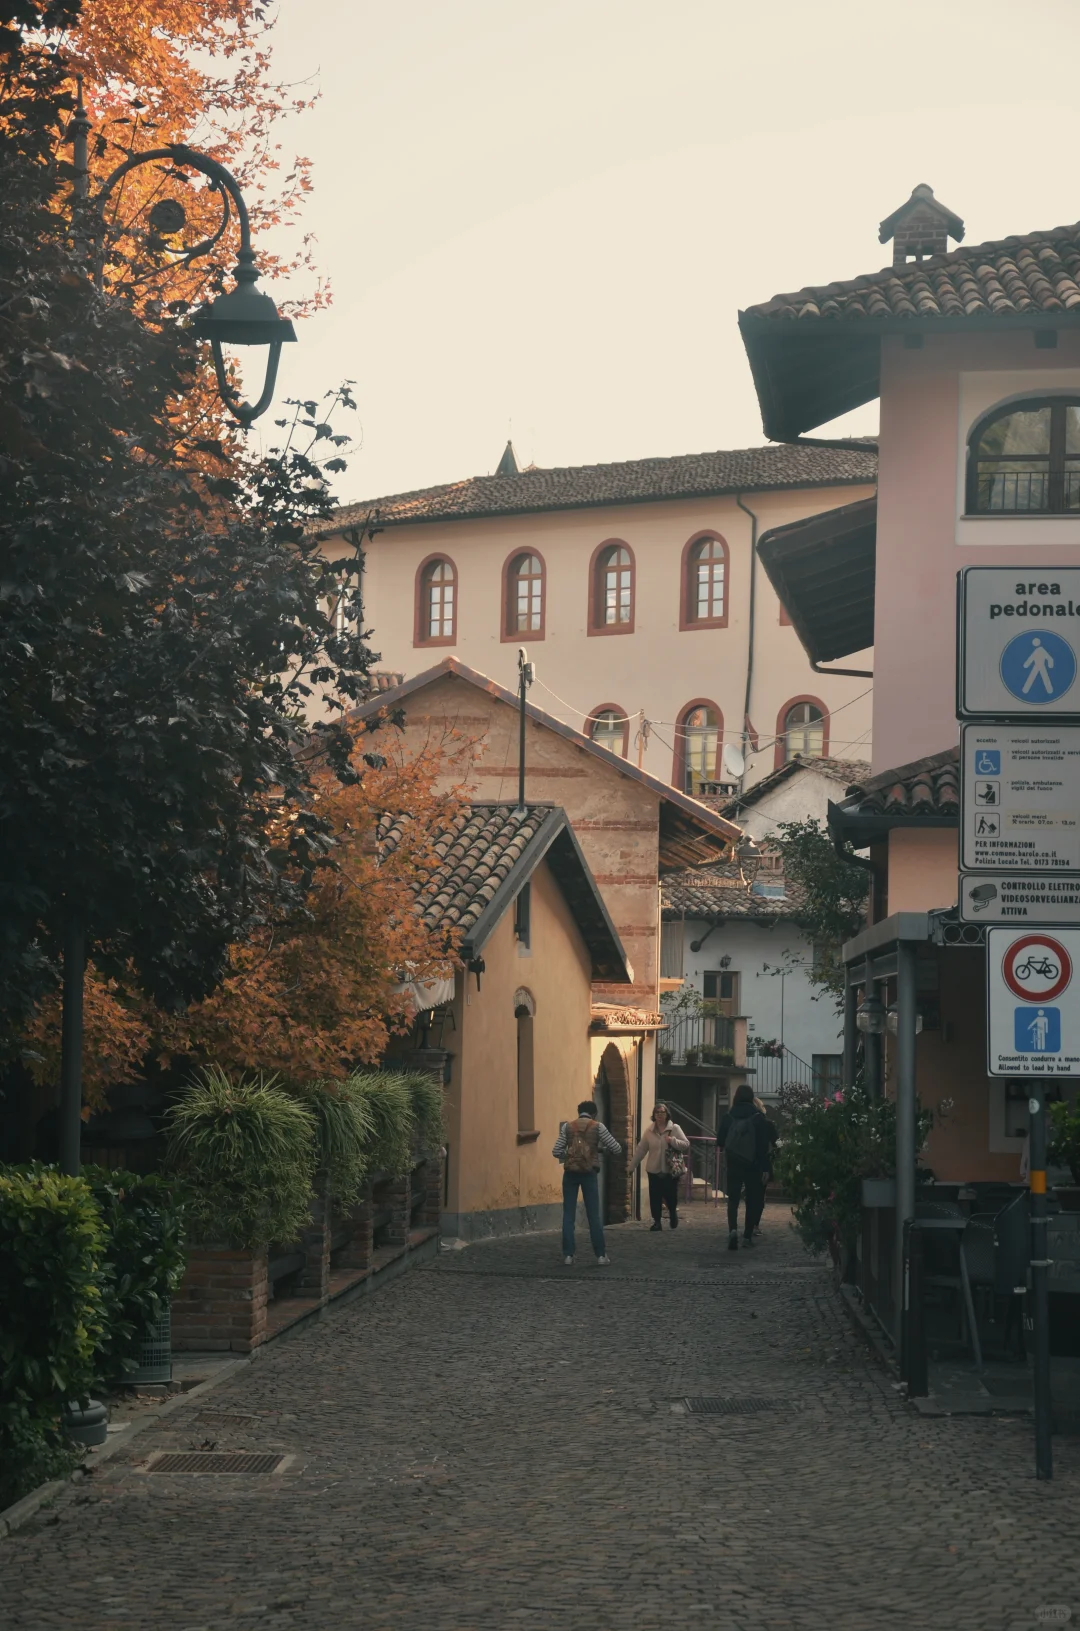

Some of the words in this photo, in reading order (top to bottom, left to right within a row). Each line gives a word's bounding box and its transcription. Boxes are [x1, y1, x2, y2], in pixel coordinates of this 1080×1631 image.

[1015, 583, 1061, 595] area
[1001, 882, 1046, 890] CONTROLLO
[1001, 907, 1027, 915] ATTIVA
